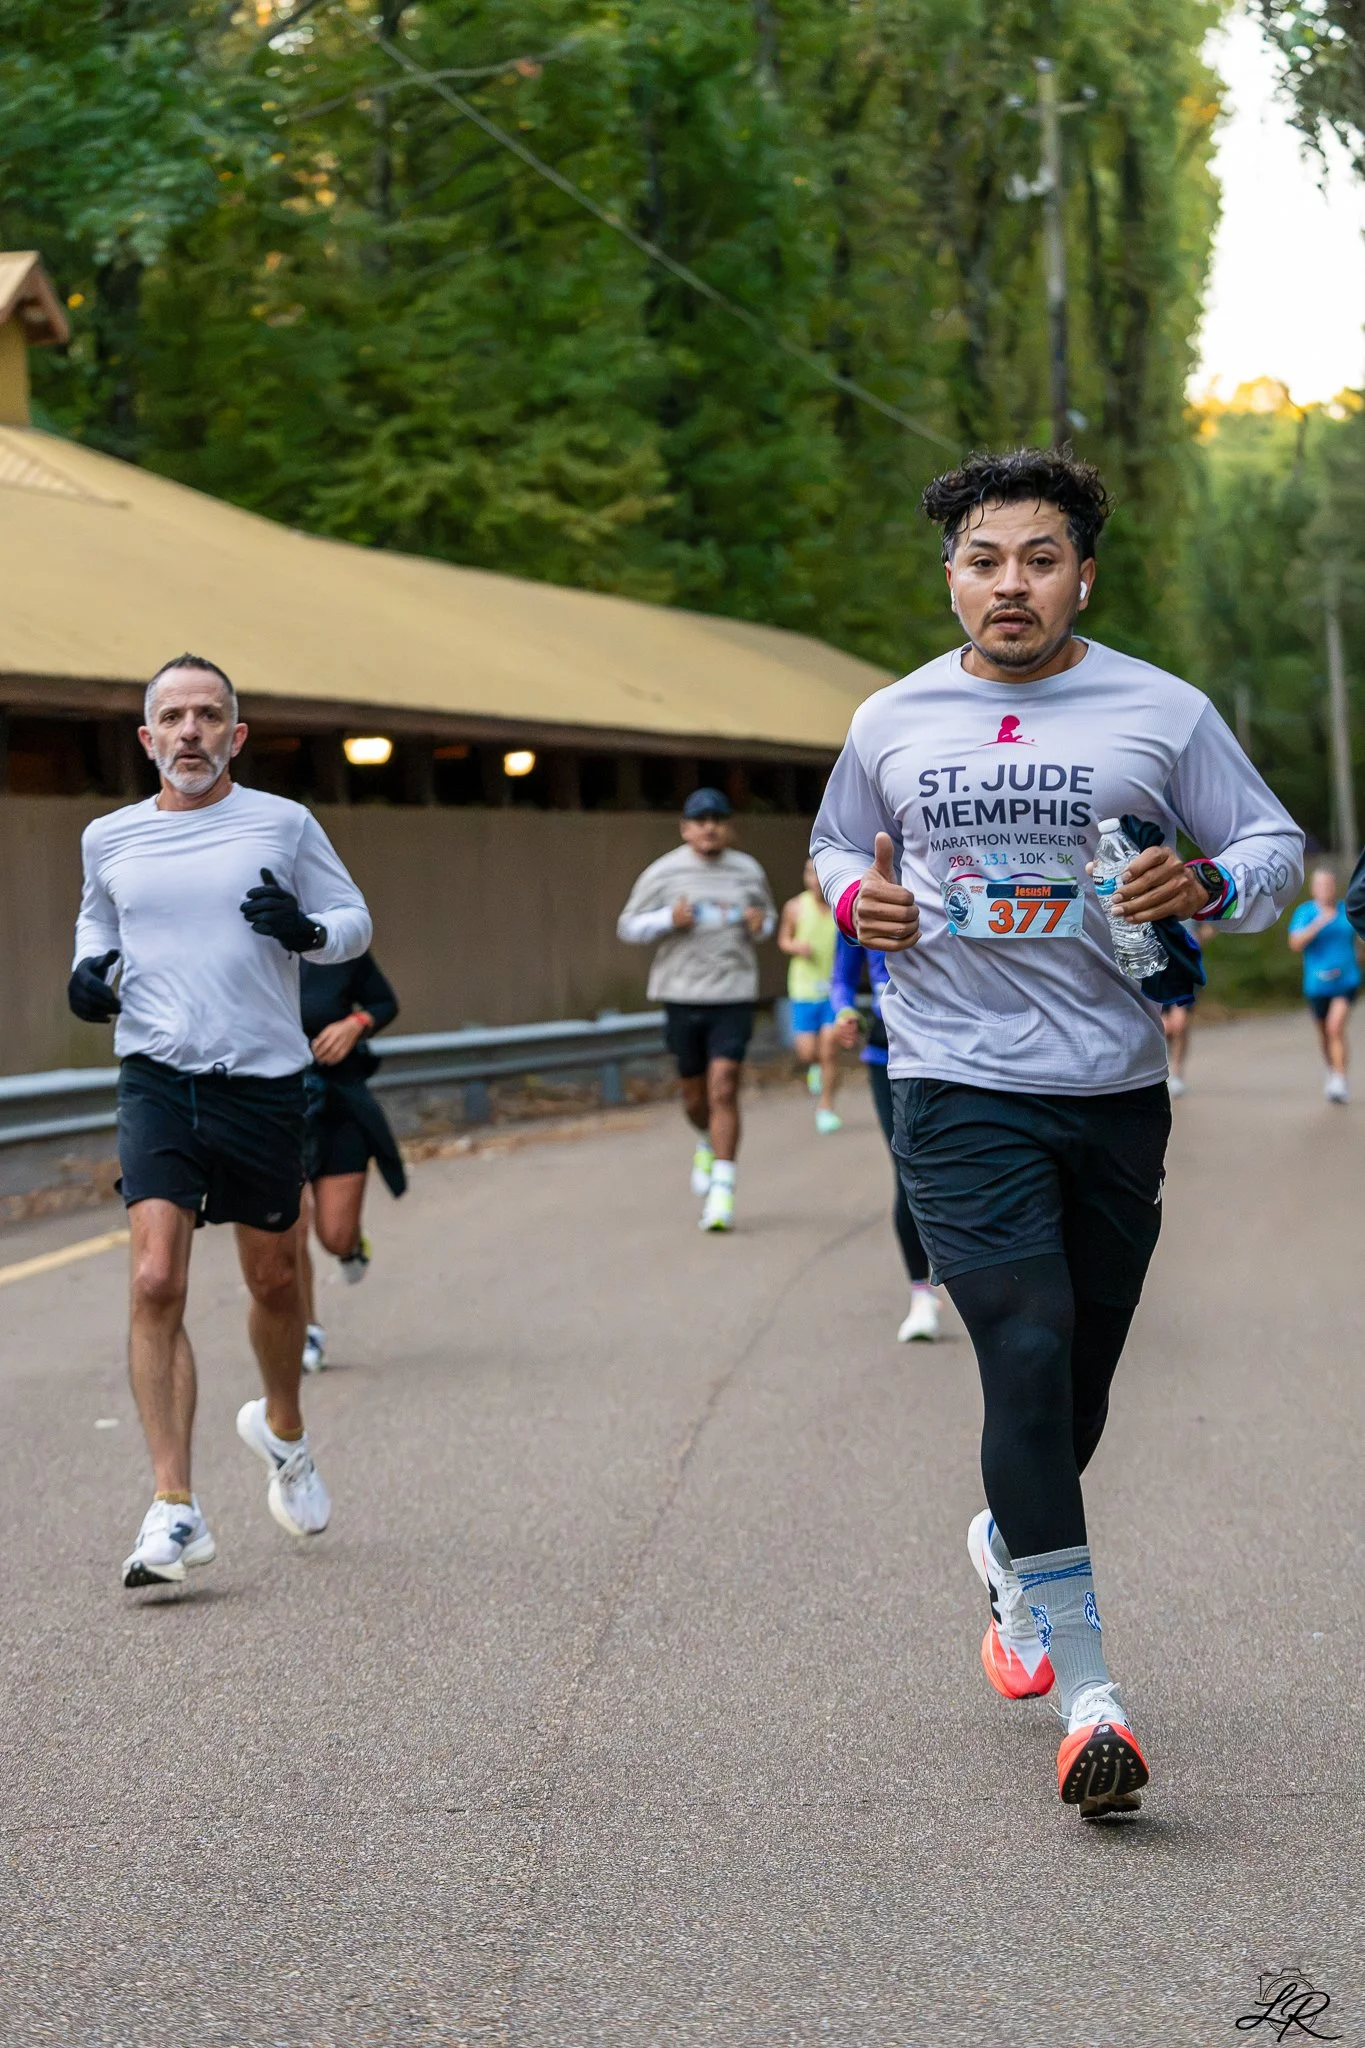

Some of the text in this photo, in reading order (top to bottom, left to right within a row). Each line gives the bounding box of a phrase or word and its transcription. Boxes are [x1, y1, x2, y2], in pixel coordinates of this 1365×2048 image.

[918, 764, 1094, 798] ST. JUDE
[921, 798, 1092, 832] MEMPHIS
[930, 833, 1087, 852] MARATHON WEEKEND
[983, 853, 1008, 866] 13.1
[1019, 852, 1046, 865] 10K
[1056, 853, 1074, 866] 5K
[1014, 885, 1052, 897] JesusM
[988, 899, 1071, 935] 377
